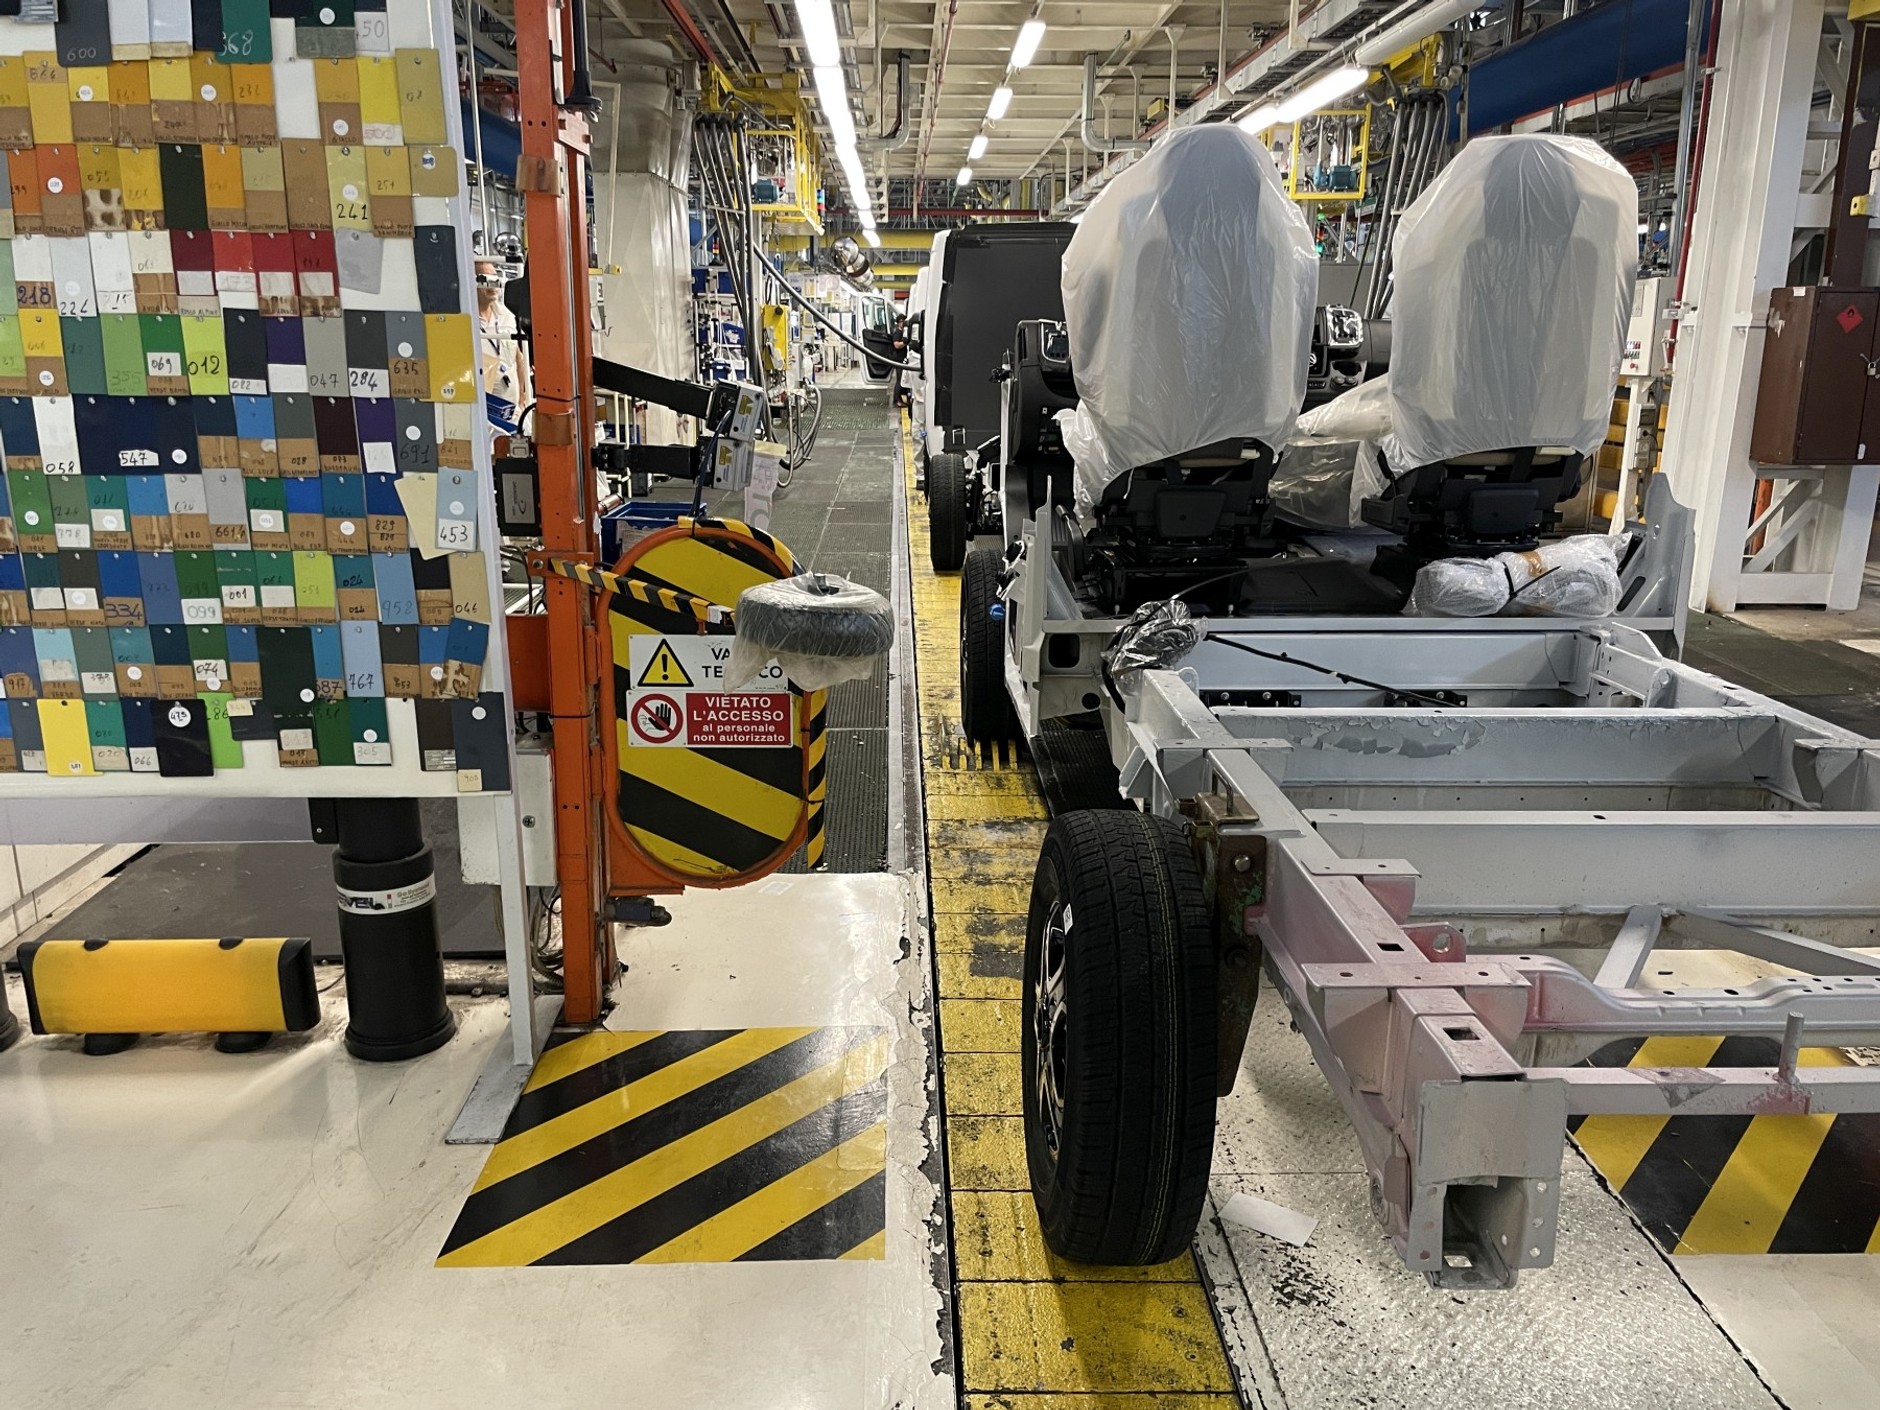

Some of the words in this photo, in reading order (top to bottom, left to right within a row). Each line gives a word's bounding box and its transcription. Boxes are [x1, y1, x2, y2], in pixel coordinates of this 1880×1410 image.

[356, 19, 386, 40] 50
[66, 46, 97, 61] 600
[336, 203, 368, 220] 241
[18, 285, 52, 305] 218
[151, 358, 173, 374] 069
[187, 354, 221, 376] 012
[393, 361, 420, 375] 635
[310, 374, 341, 390] 047
[350, 370, 378, 391] 284
[121, 452, 148, 467] 547
[400, 445, 431, 464] 691
[46, 461, 76, 474] 058
[375, 519, 396, 533] 829
[440, 524, 469, 543] 453
[229, 588, 248, 600] 001
[106, 603, 144, 619] 334
[195, 662, 218, 680] 074
[349, 674, 375, 691] 767
[705, 696, 772, 708] VIETATO
[207, 707, 230, 720] 86
[693, 710, 784, 722] L'ACCESSO
[702, 724, 714, 733] al
[717, 724, 776, 735] personale
[693, 734, 716, 742] non
[719, 733, 786, 743] autorizzato
